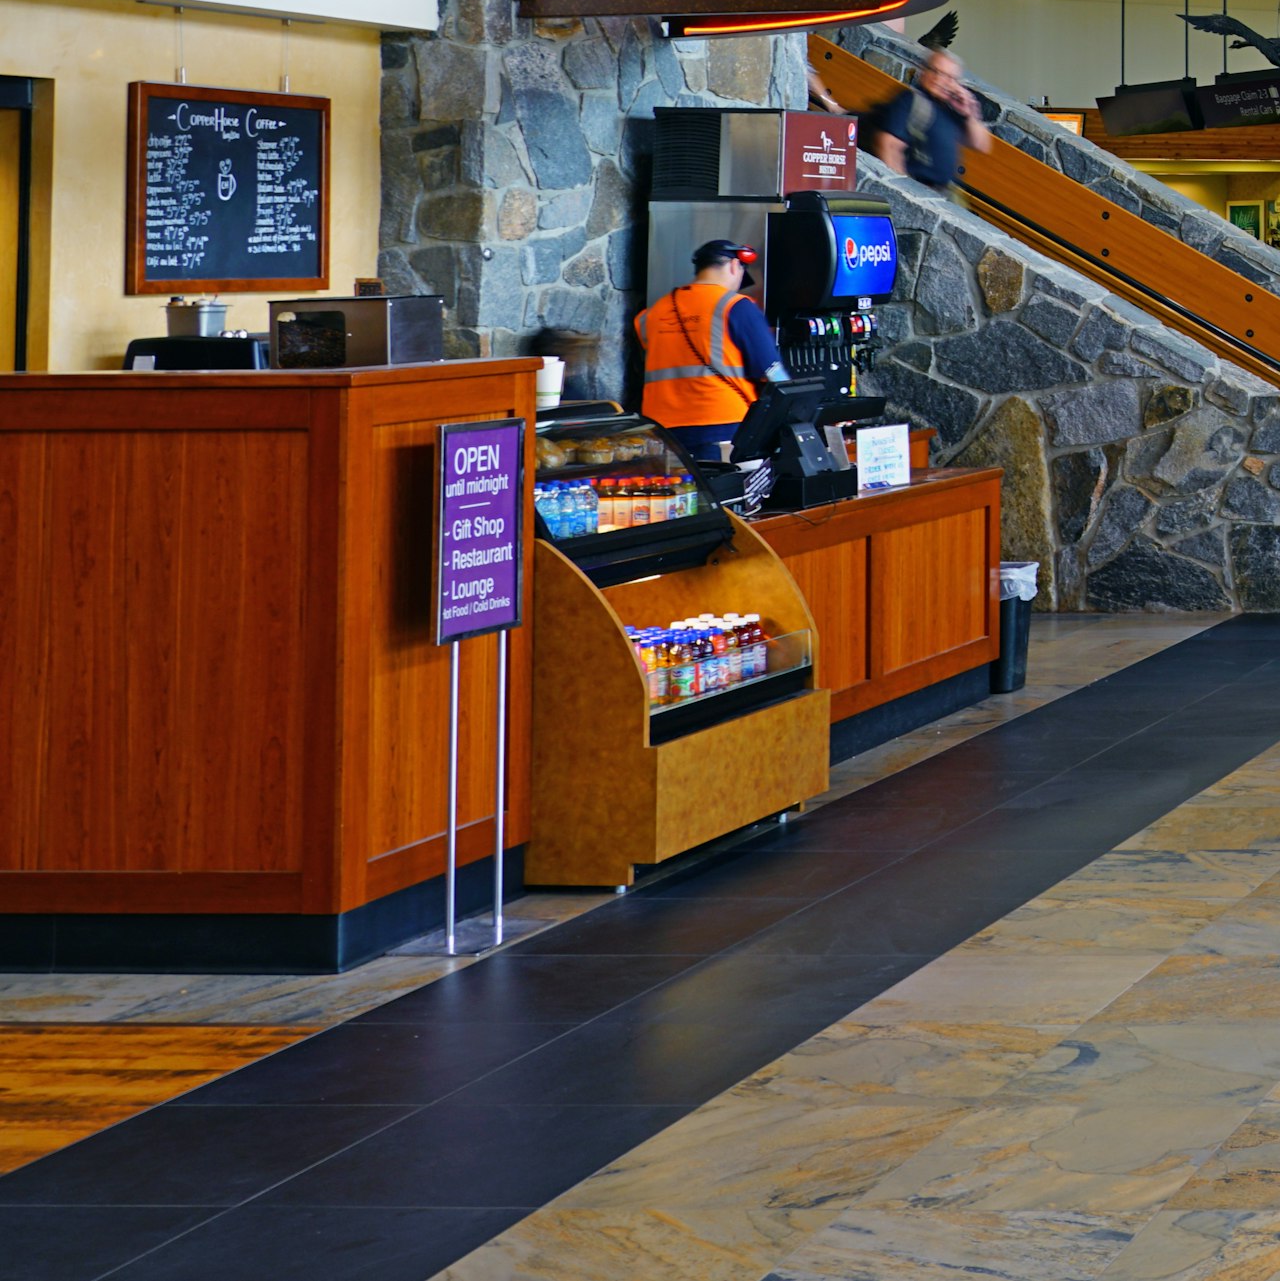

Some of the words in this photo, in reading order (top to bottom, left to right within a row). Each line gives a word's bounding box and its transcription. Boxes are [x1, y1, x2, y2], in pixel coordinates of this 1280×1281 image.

[1214, 93, 1241, 106] Baggage
[1240, 90, 1258, 101] Claim
[1257, 88, 1269, 99] 2-3
[1239, 105, 1259, 116] Rental
[1259, 104, 1274, 115] Cars
[802, 152, 828, 164] COPPER
[828, 154, 847, 166] HORSE
[859, 240, 892, 268] pepsi
[454, 443, 500, 476] OPEN
[445, 478, 465, 498] until
[467, 473, 509, 495] midnight
[453, 518, 473, 541] Gift
[474, 516, 505, 539] Shop
[452, 541, 513, 571] Restaurant
[452, 577, 494, 601] Lounge
[453, 603, 469, 618] Food
[474, 600, 489, 614] Cold
[490, 596, 511, 611] Drinks
